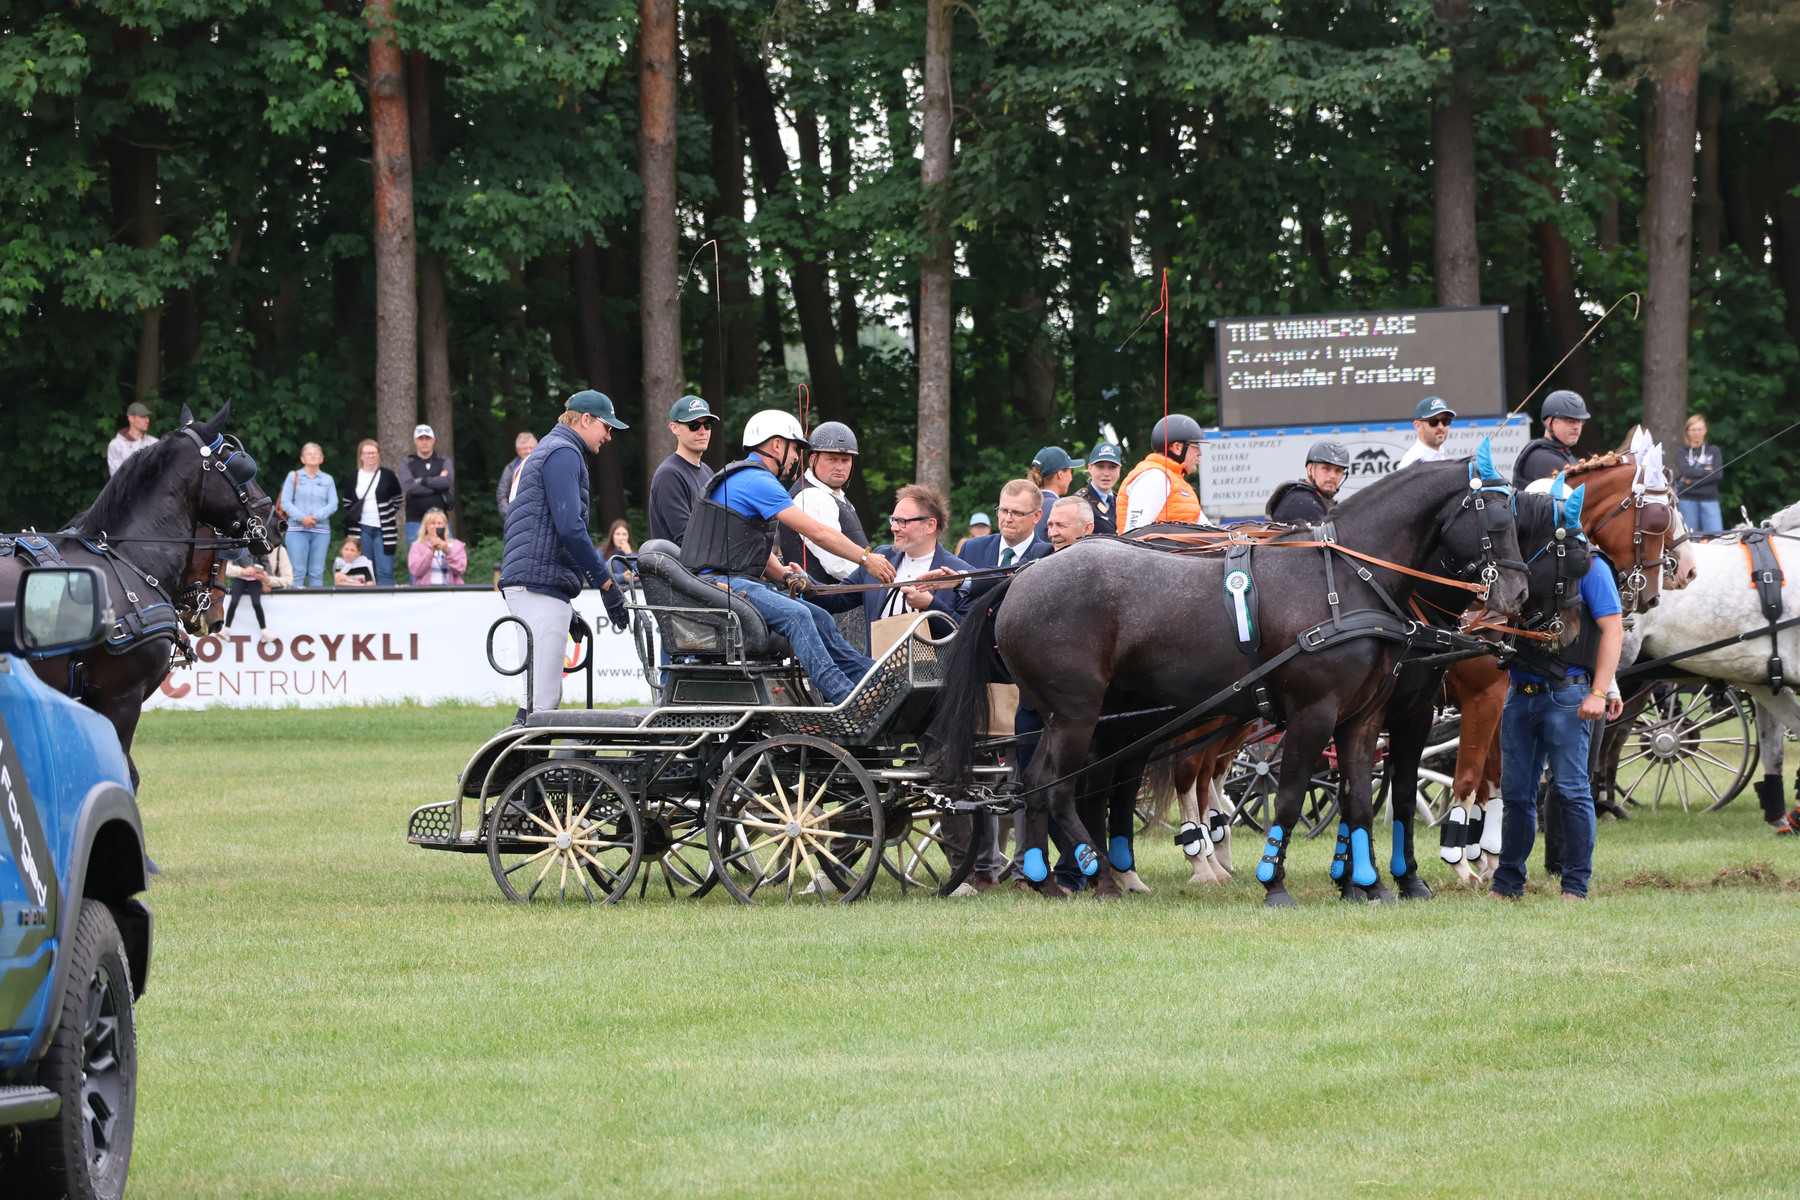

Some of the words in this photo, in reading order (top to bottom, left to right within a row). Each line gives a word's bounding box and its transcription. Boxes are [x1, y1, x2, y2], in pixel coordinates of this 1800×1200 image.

[1226, 323, 1270, 342] THE
[1272, 317, 1369, 340] WINNERS
[1372, 315, 1416, 336] ARE
[1227, 368, 1337, 390] Christoffer
[1341, 364, 1436, 386] Forsberg
[18, 909, 48, 926] RAM
